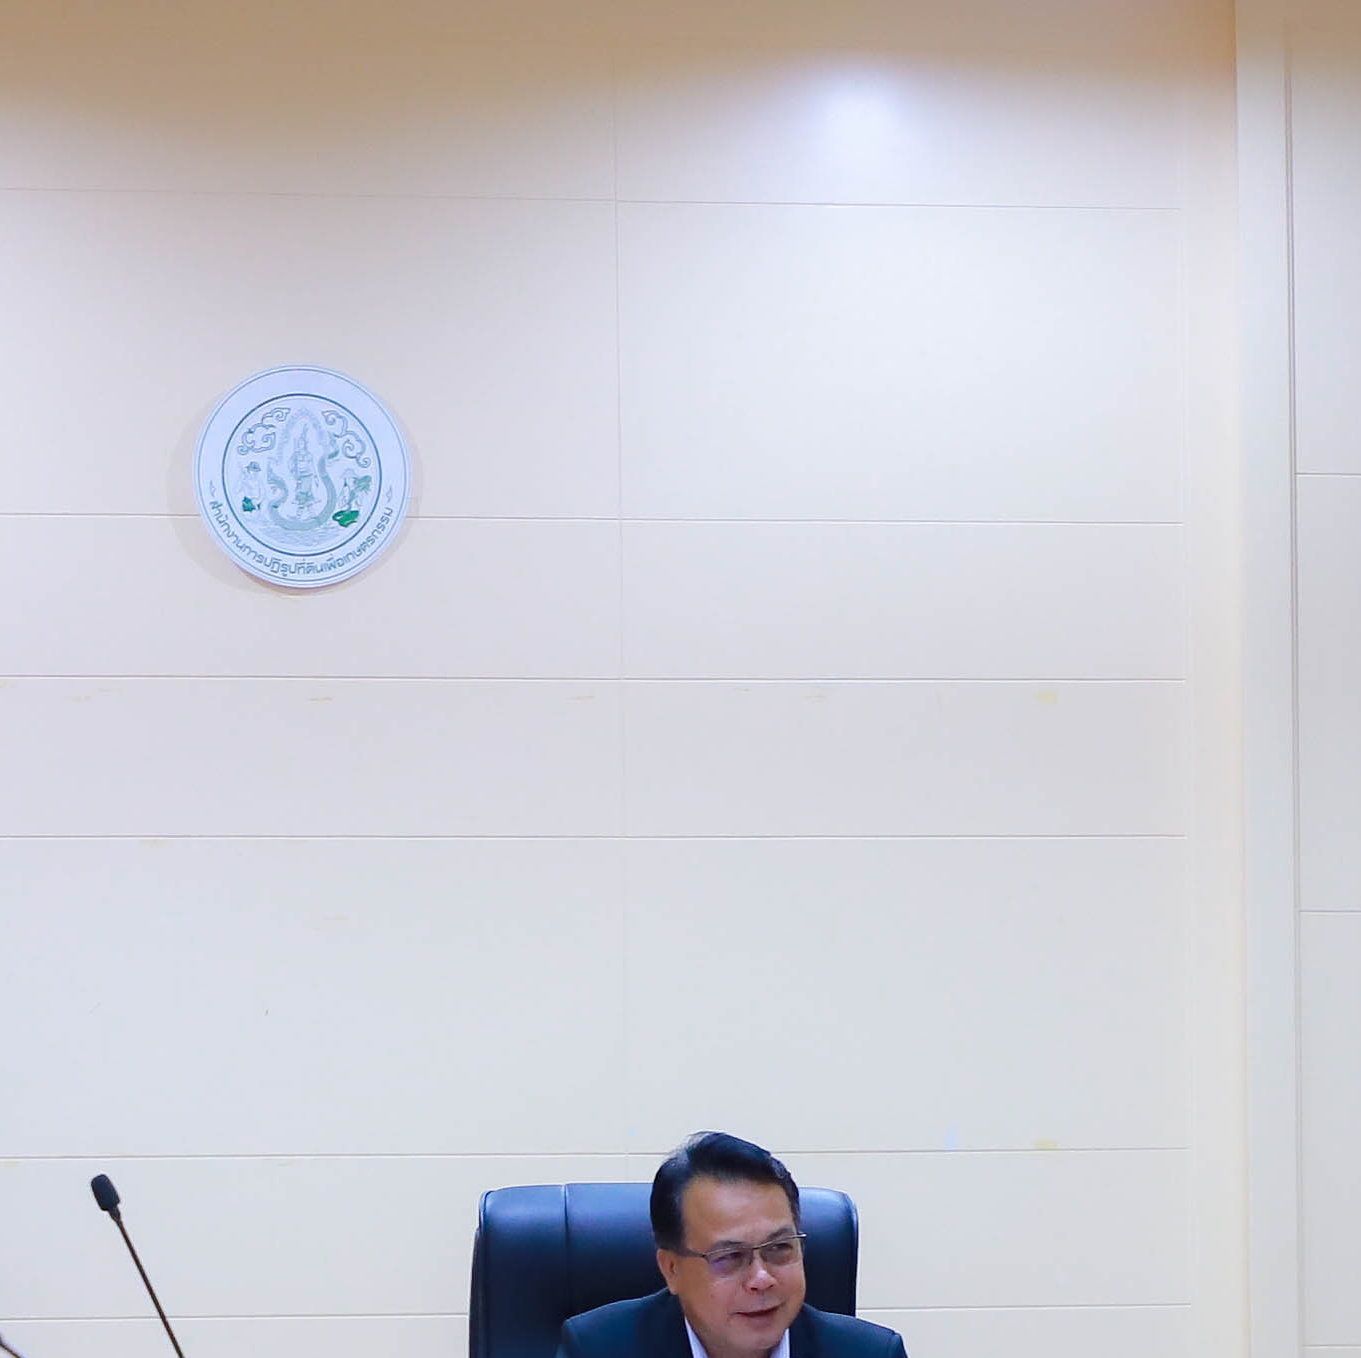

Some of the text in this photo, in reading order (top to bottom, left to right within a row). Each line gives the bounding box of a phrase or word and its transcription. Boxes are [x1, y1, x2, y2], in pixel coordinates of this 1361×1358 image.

[209, 500, 394, 577] สำนักงานการปฏิรูปที่ดินเพื่อเกษตรกรรม
